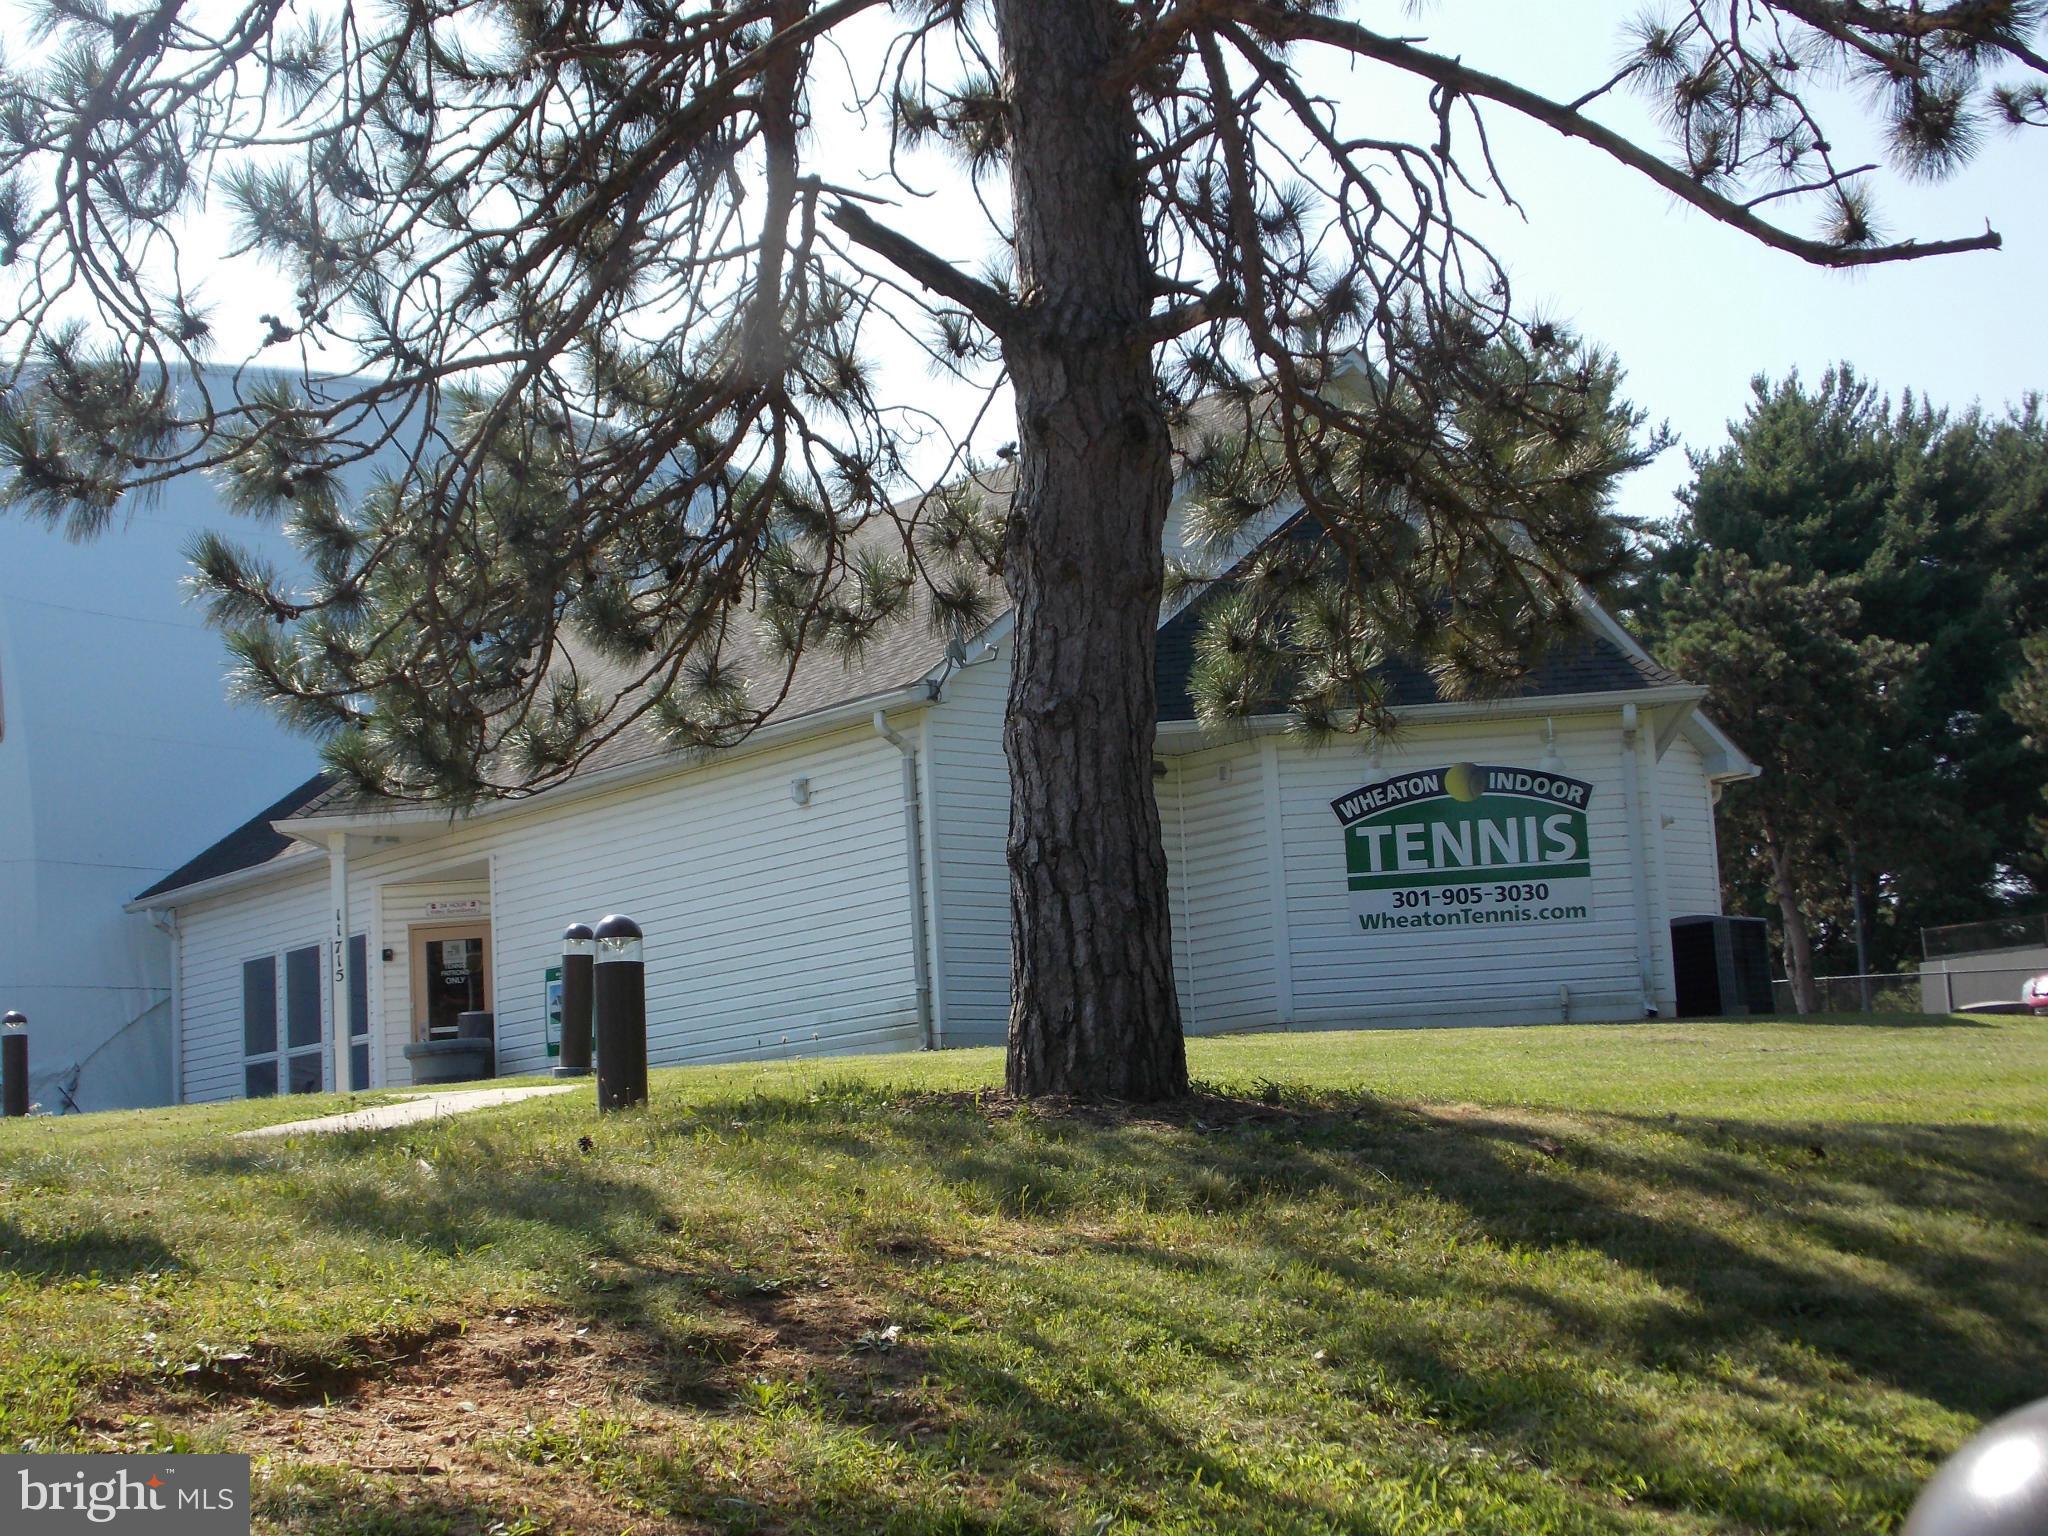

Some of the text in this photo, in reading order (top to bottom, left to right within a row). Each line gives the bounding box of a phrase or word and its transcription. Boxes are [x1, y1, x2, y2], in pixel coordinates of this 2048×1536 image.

[1339, 772, 1585, 819] WHEATON INDOOR
[1356, 813, 1577, 872] TENNIS
[1392, 883, 1550, 909] 301-905-3030
[1358, 904, 1587, 930] WheatonTennis.com
[334, 908, 345, 983] 11715
[445, 976, 466, 985] ONLY
